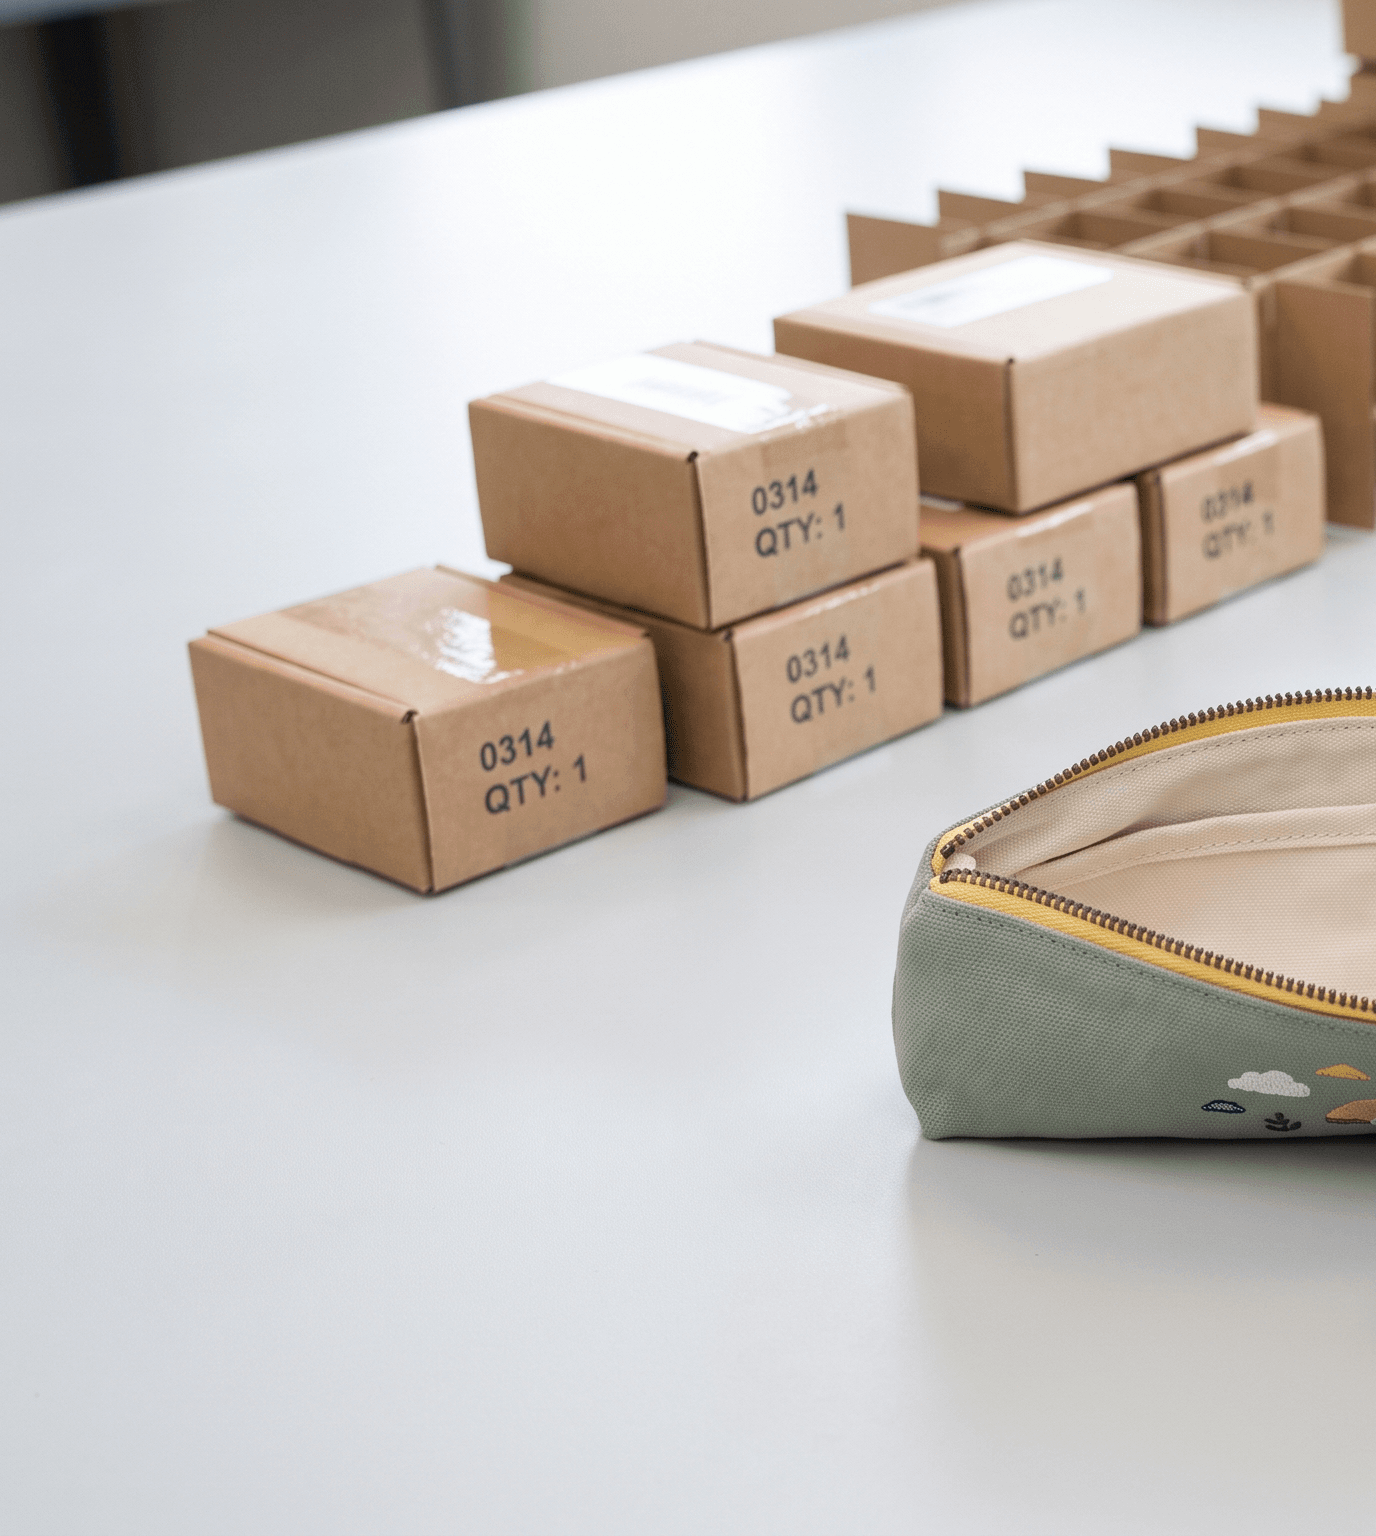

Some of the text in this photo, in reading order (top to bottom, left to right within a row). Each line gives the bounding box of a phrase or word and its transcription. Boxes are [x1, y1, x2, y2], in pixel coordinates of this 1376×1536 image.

[752, 469, 818, 516] 0314
[755, 503, 845, 558] QTY: 1
[1203, 521, 1255, 559] QTY
[1007, 557, 1064, 602] 0314
[1074, 588, 1086, 613] 1
[786, 634, 850, 684] 0314
[790, 665, 876, 724] QTY: 1
[480, 719, 555, 772] 0314
[484, 753, 587, 815] QTY: 1
